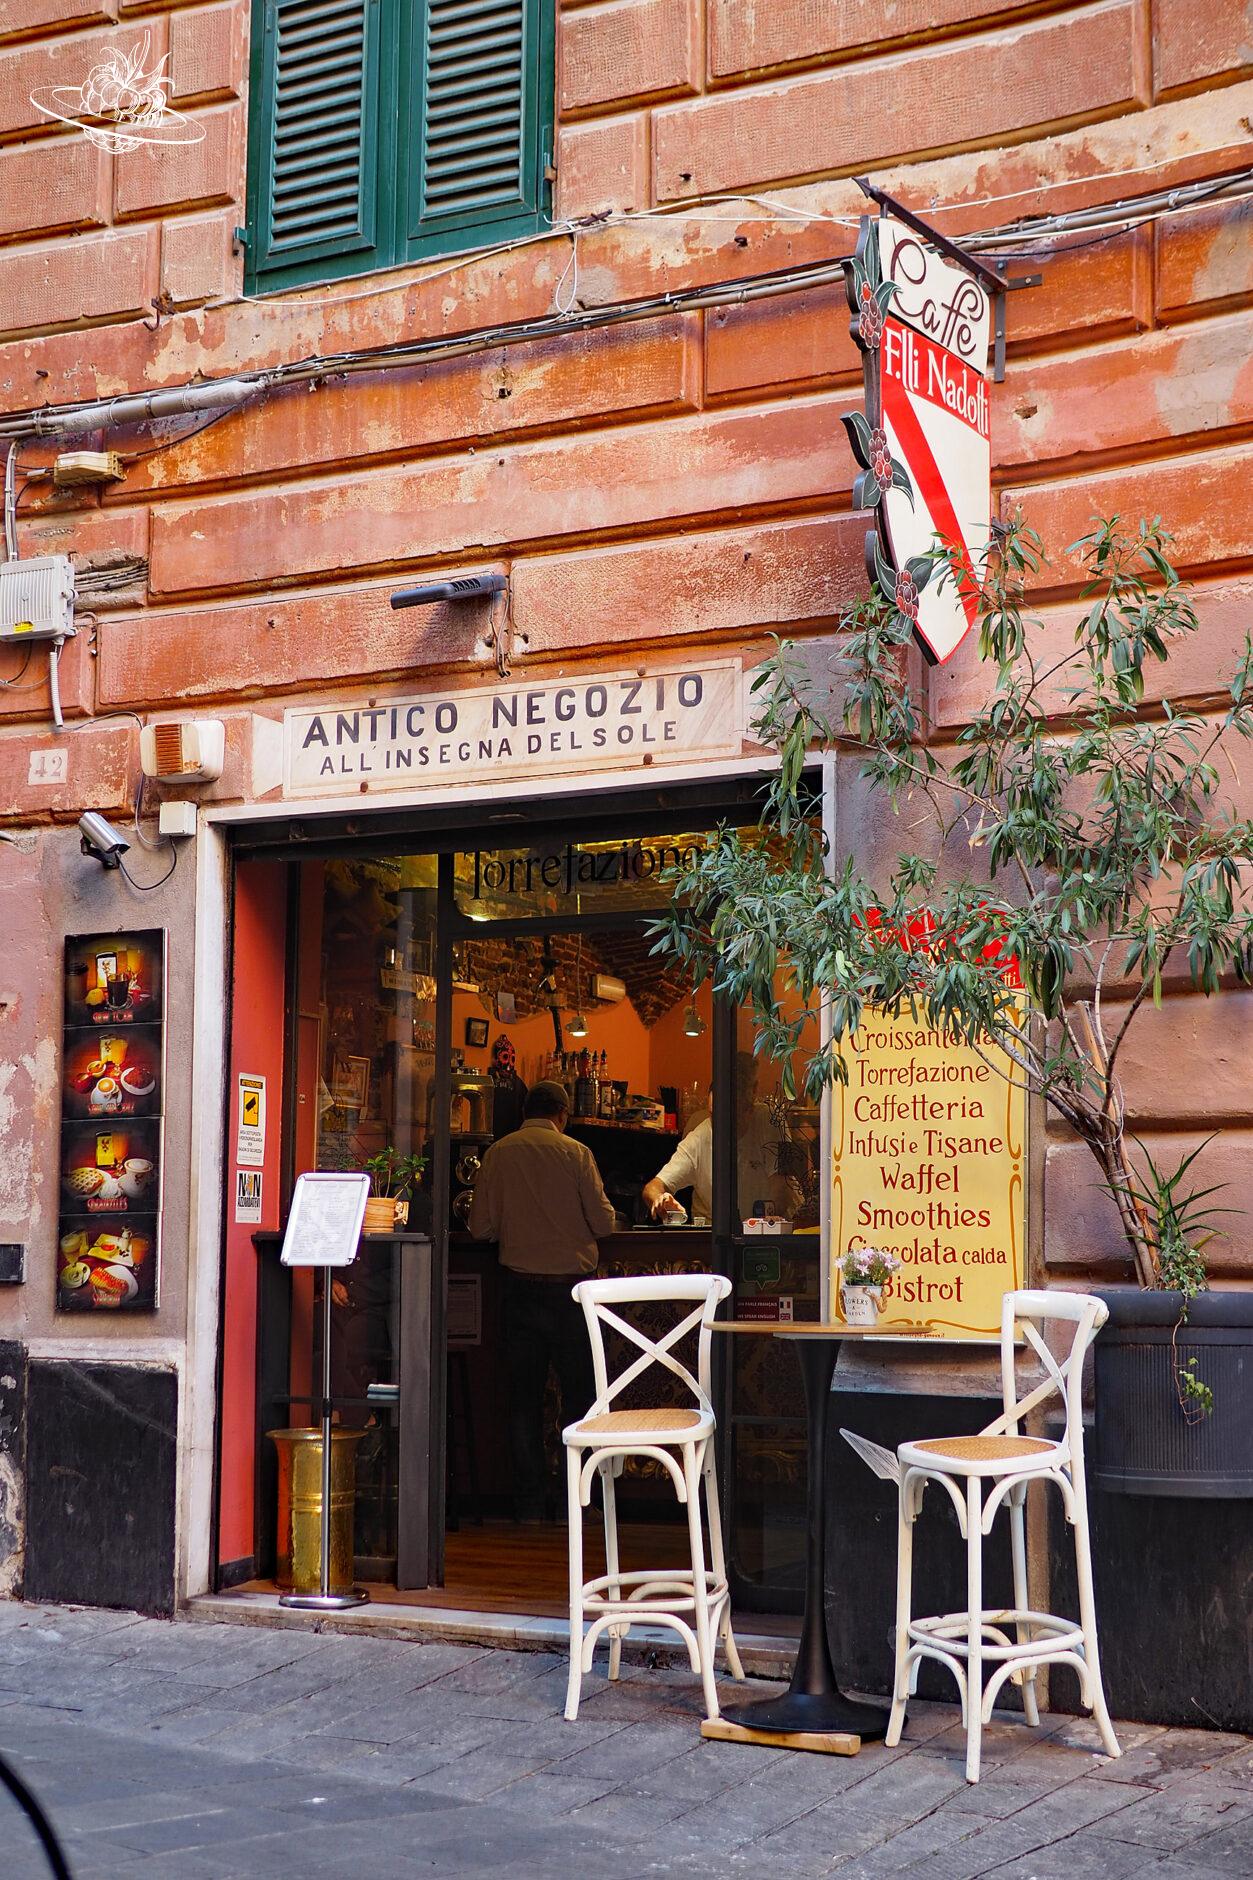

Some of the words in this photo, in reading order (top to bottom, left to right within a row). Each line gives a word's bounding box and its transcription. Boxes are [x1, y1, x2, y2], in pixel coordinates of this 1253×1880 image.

[885, 326, 919, 393] F.lli
[927, 349, 989, 436] Nadotti
[302, 702, 458, 748] ANTICO
[492, 673, 703, 729] NEGOZIO
[35, 756, 62, 778] 42
[856, 1058, 990, 1087] Torrefazione
[854, 1094, 985, 1123] Caffetteria
[849, 1130, 906, 1157] Infusi
[909, 1141, 918, 1154] e
[923, 1129, 1003, 1158] Tisane
[879, 1163, 960, 1194] Waffel
[857, 1200, 991, 1231] Smoothies
[848, 1235, 958, 1265] Ccolata
[962, 1248, 1007, 1265] calda
[881, 1274, 964, 1303] Bistrot
